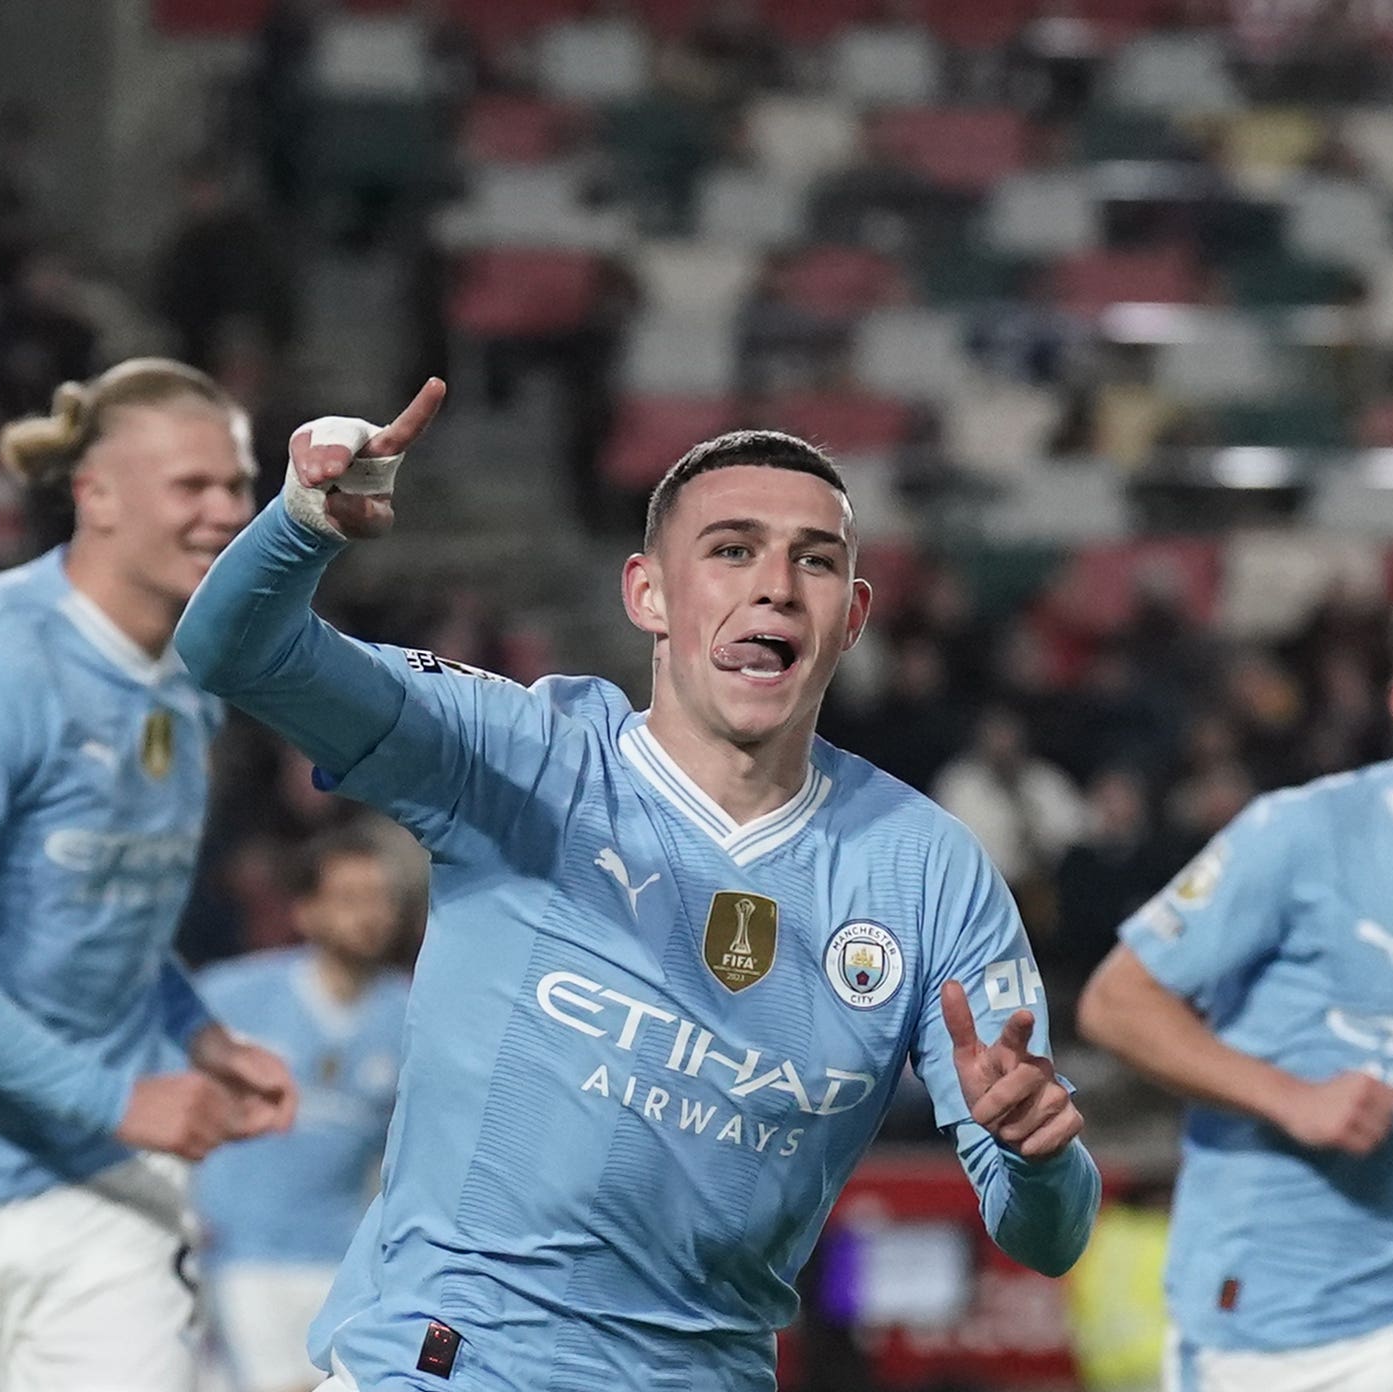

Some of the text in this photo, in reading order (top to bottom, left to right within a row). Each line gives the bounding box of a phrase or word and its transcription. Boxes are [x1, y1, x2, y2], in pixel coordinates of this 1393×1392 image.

[832, 926, 897, 955] MANCHESTER
[722, 953, 754, 970] FIFA
[850, 994, 874, 1003] CITY
[536, 971, 876, 1115] ETIHAD
[581, 1064, 805, 1156] AIRWAYS
